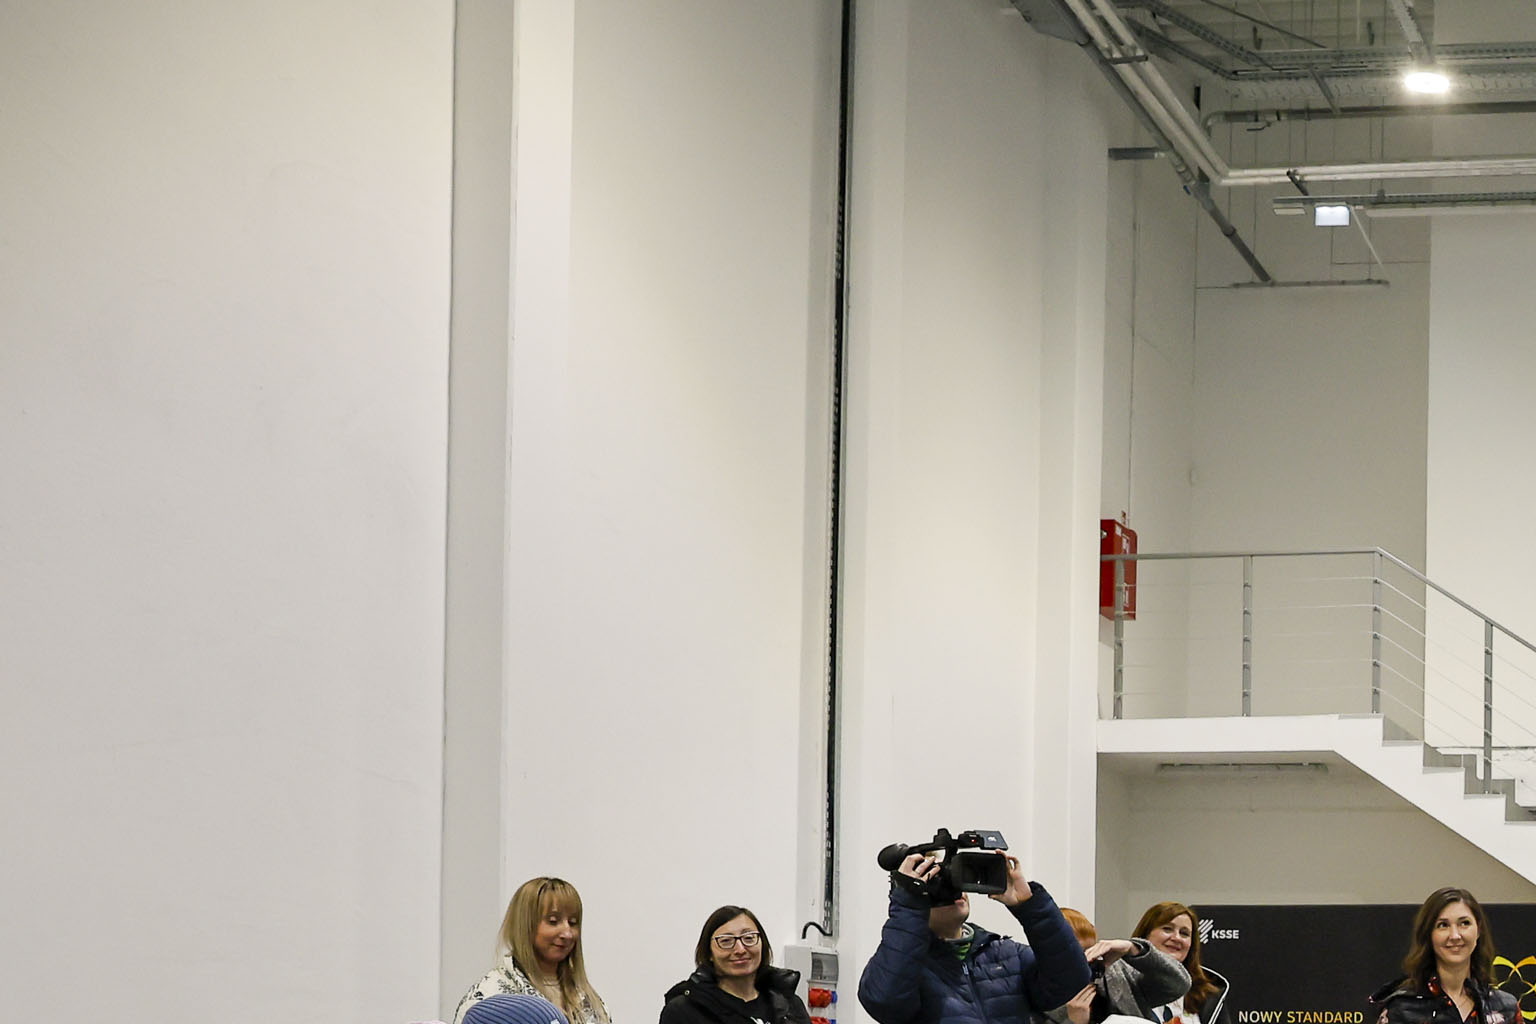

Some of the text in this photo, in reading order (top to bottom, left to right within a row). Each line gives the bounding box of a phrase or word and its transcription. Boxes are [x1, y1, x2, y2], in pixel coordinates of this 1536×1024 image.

[1211, 929, 1240, 939] KSSE
[1238, 1010, 1364, 1024] NOWY STANDARD
